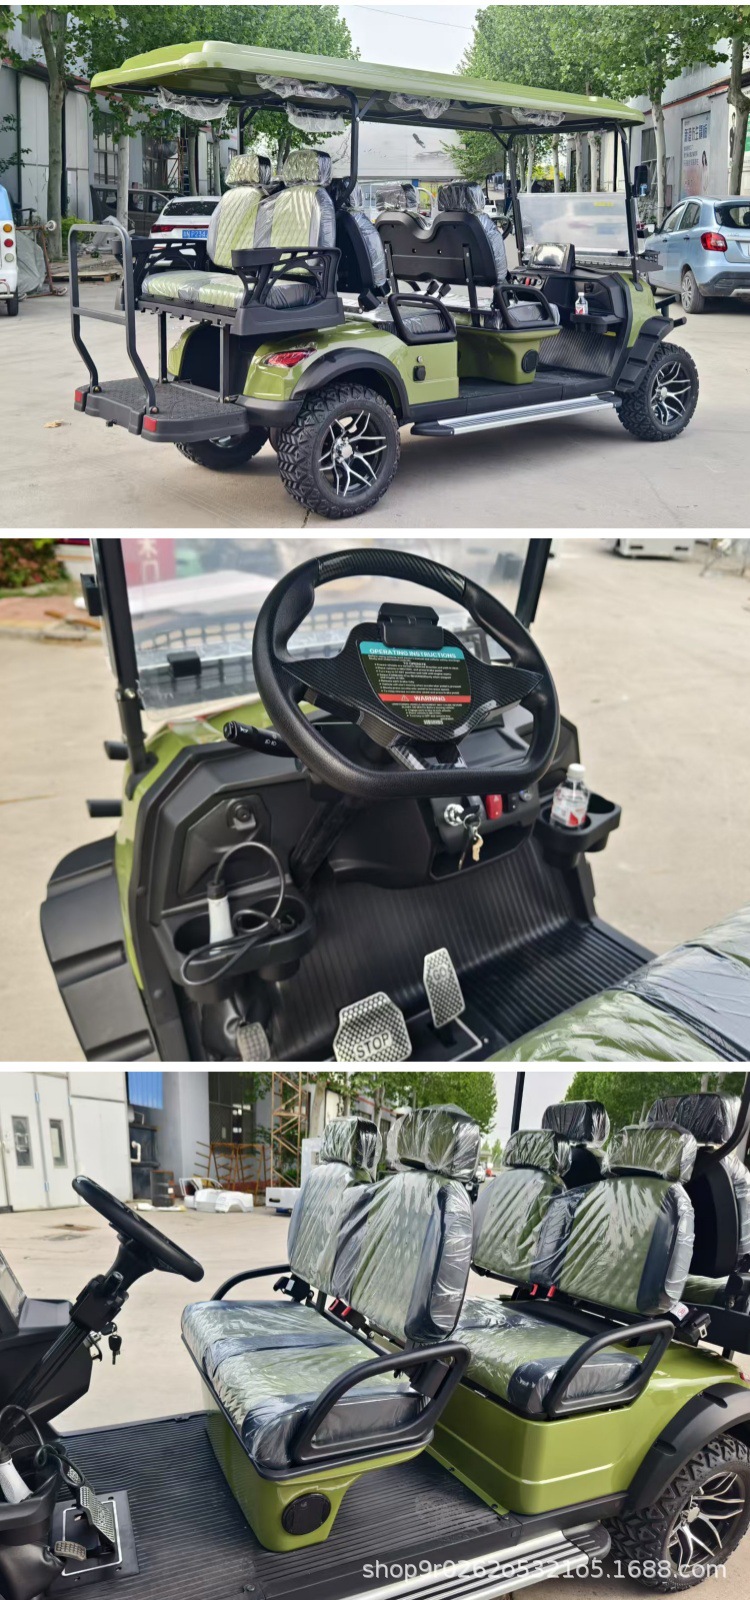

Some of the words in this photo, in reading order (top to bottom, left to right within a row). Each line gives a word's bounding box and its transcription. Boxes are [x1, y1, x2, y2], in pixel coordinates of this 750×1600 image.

[369, 648, 408, 657] OPERATING
[409, 649, 457, 659] INSTRUCTIONS
[432, 966, 447, 981] GO
[356, 1031, 389, 1059] STOP
